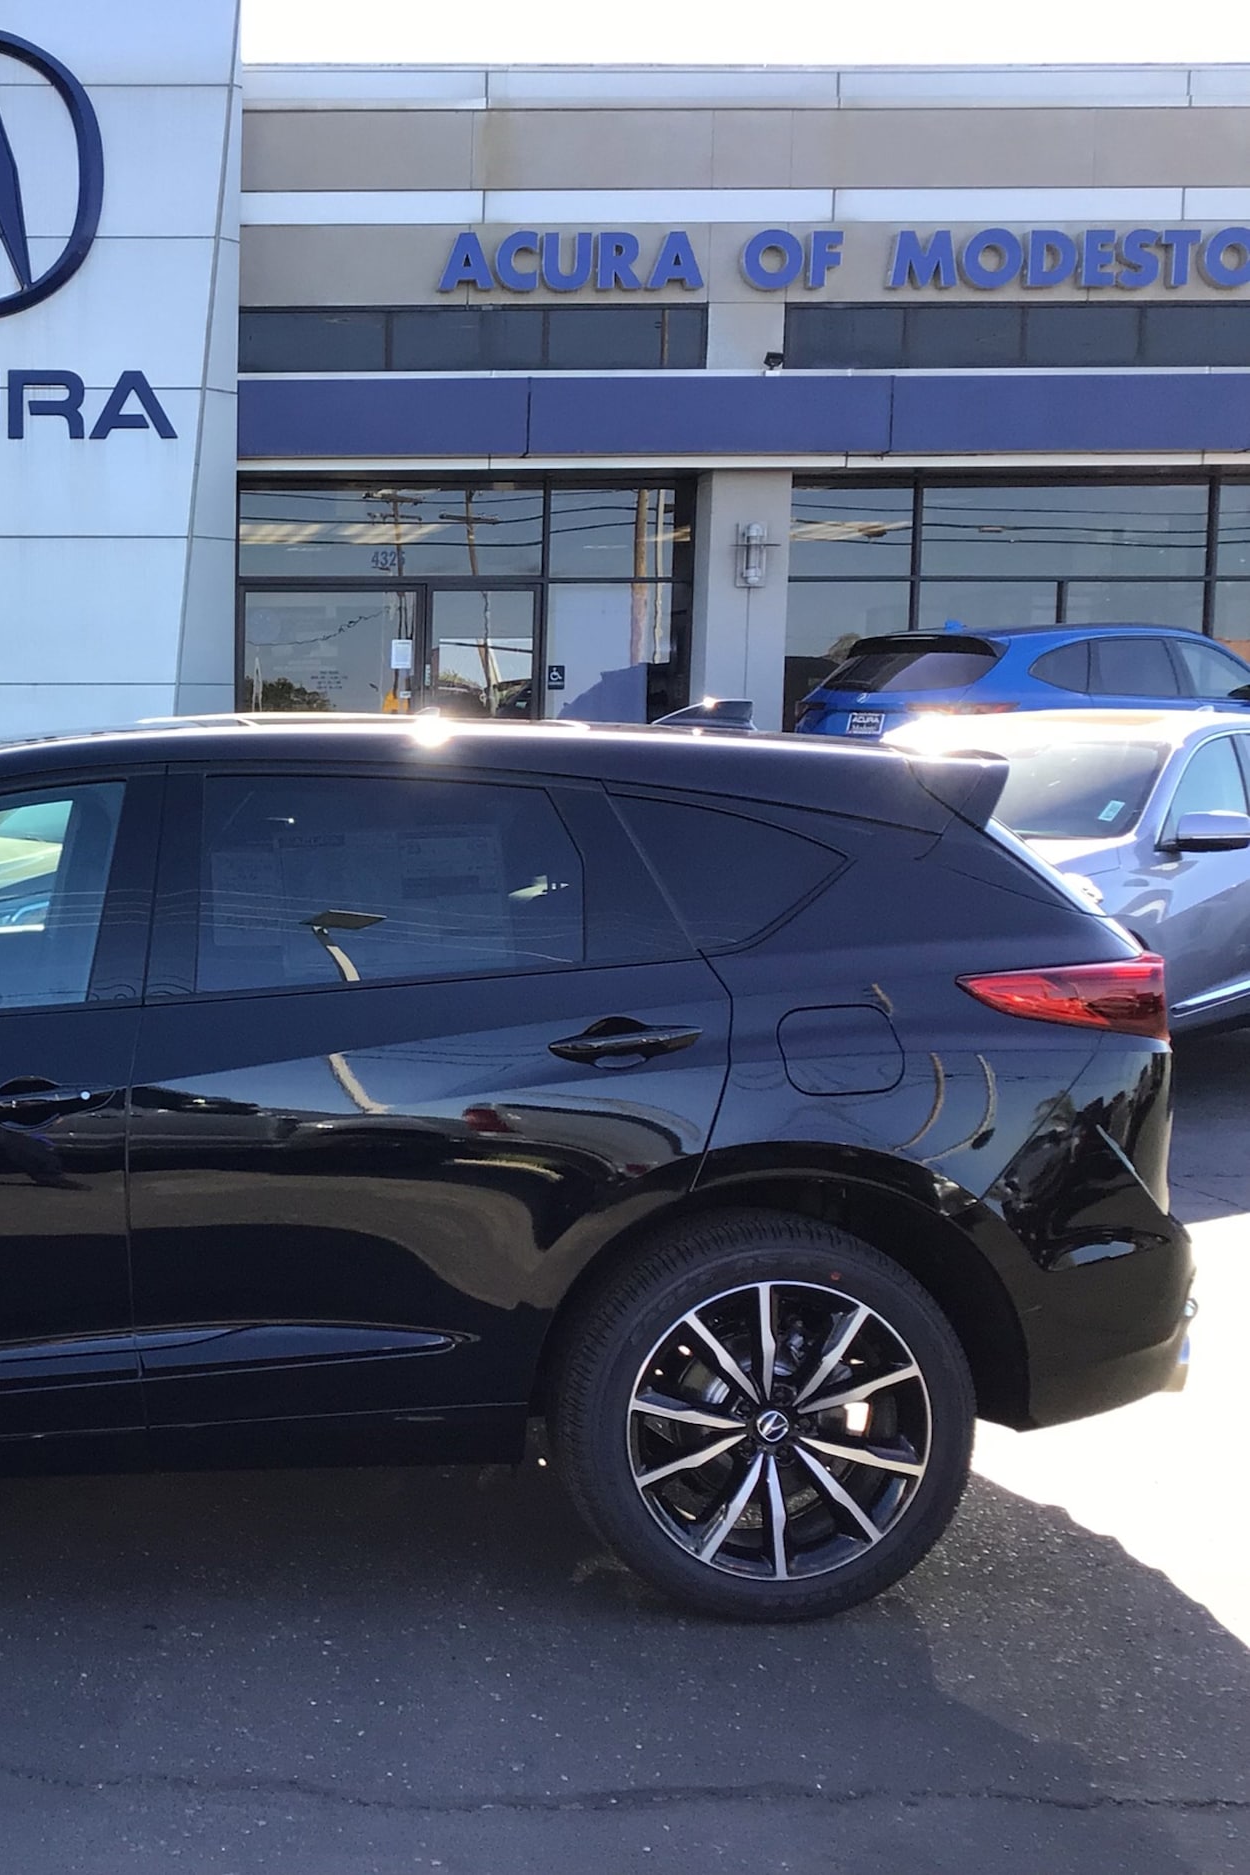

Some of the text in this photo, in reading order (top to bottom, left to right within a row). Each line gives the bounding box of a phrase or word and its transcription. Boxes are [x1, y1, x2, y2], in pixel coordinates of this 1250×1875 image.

[438, 226, 1250, 292] ACURA OF MODESTO
